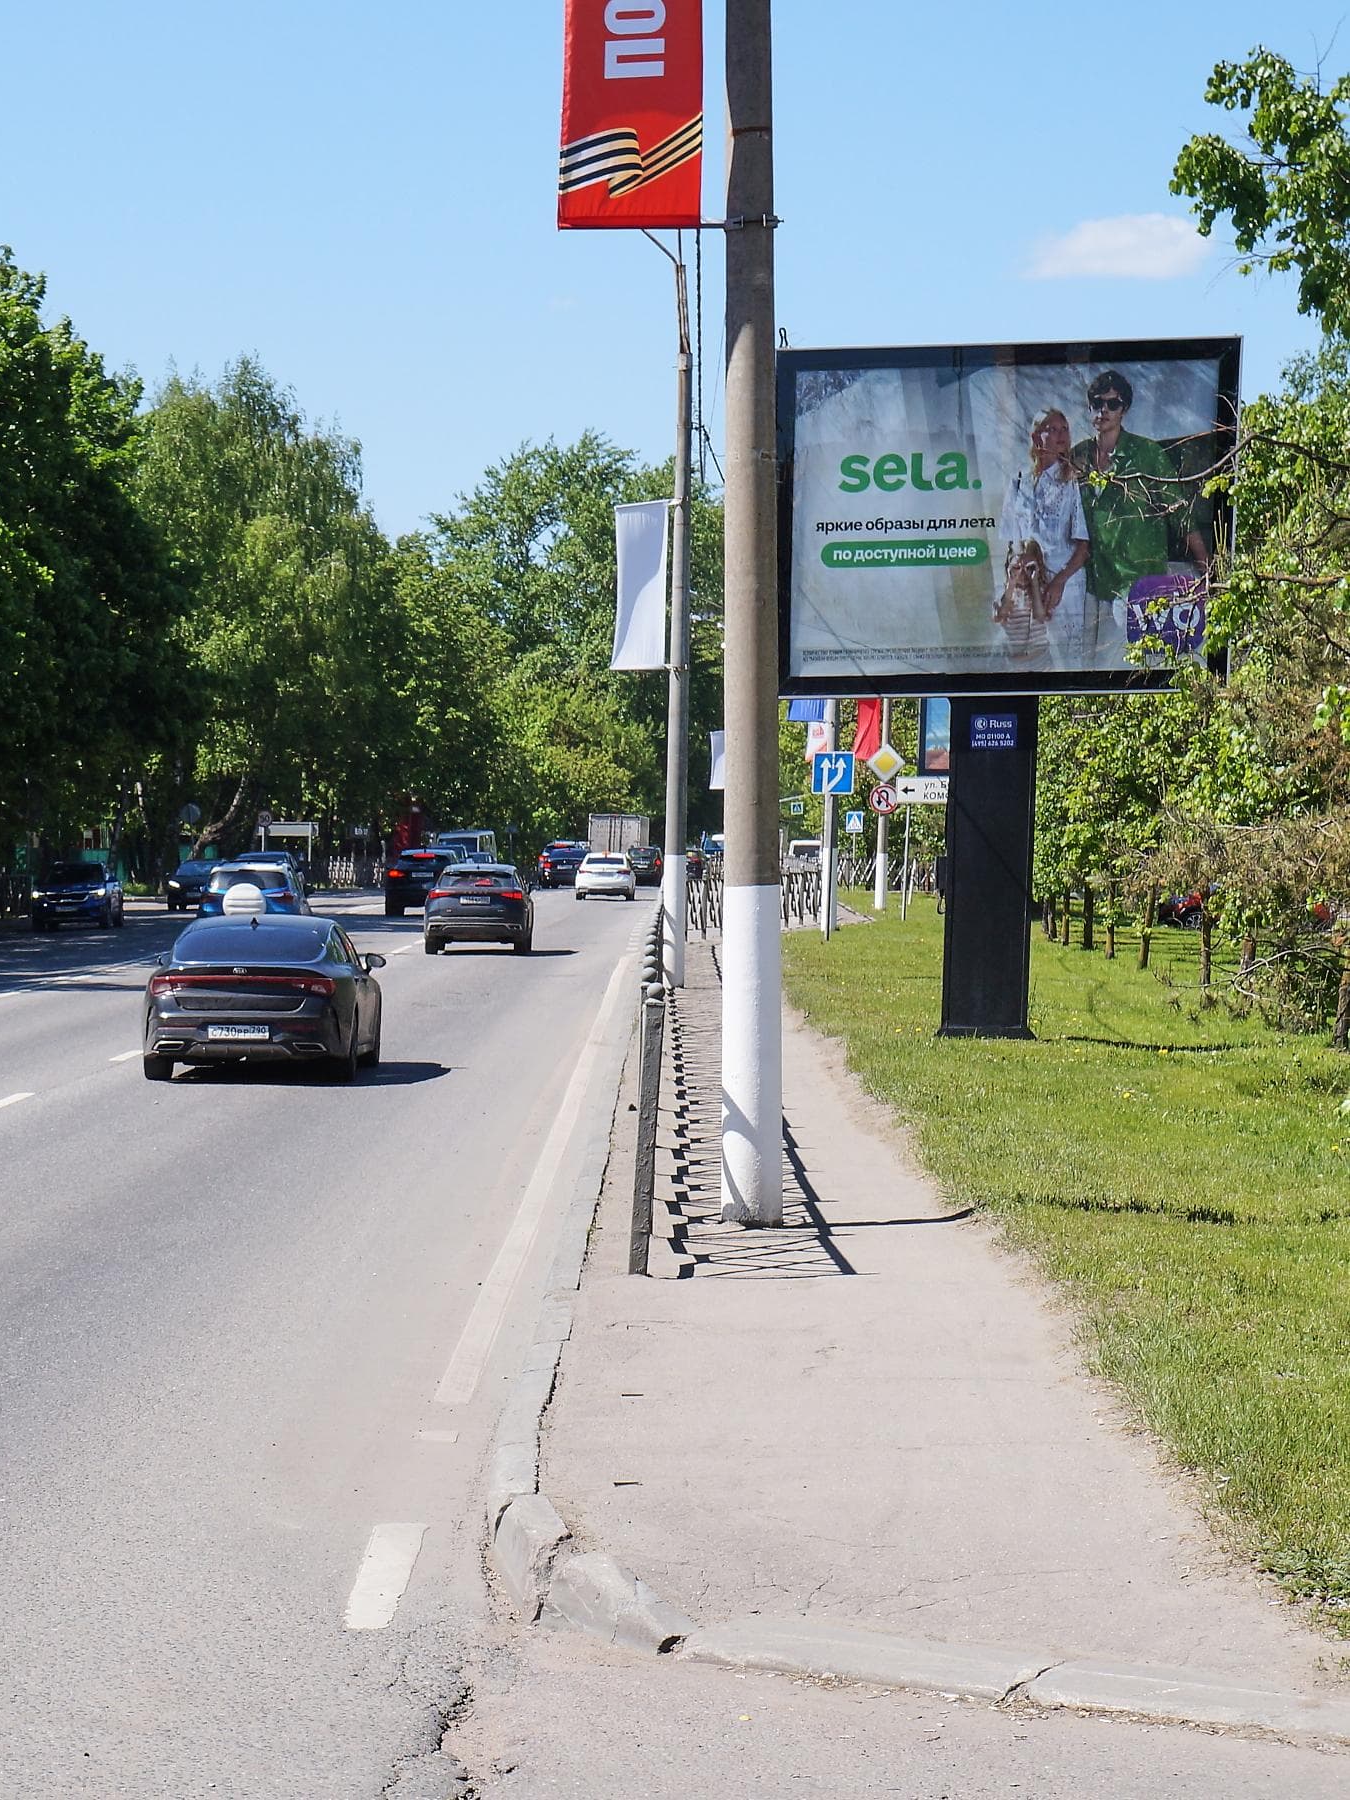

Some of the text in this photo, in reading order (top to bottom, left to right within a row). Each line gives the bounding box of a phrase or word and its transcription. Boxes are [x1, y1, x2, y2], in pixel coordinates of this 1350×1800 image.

[838, 450, 983, 493] sela.
[816, 516, 996, 535] яркие образы для лета
[833, 544, 977, 562] по доступной цене
[989, 719, 1012, 728] Russ
